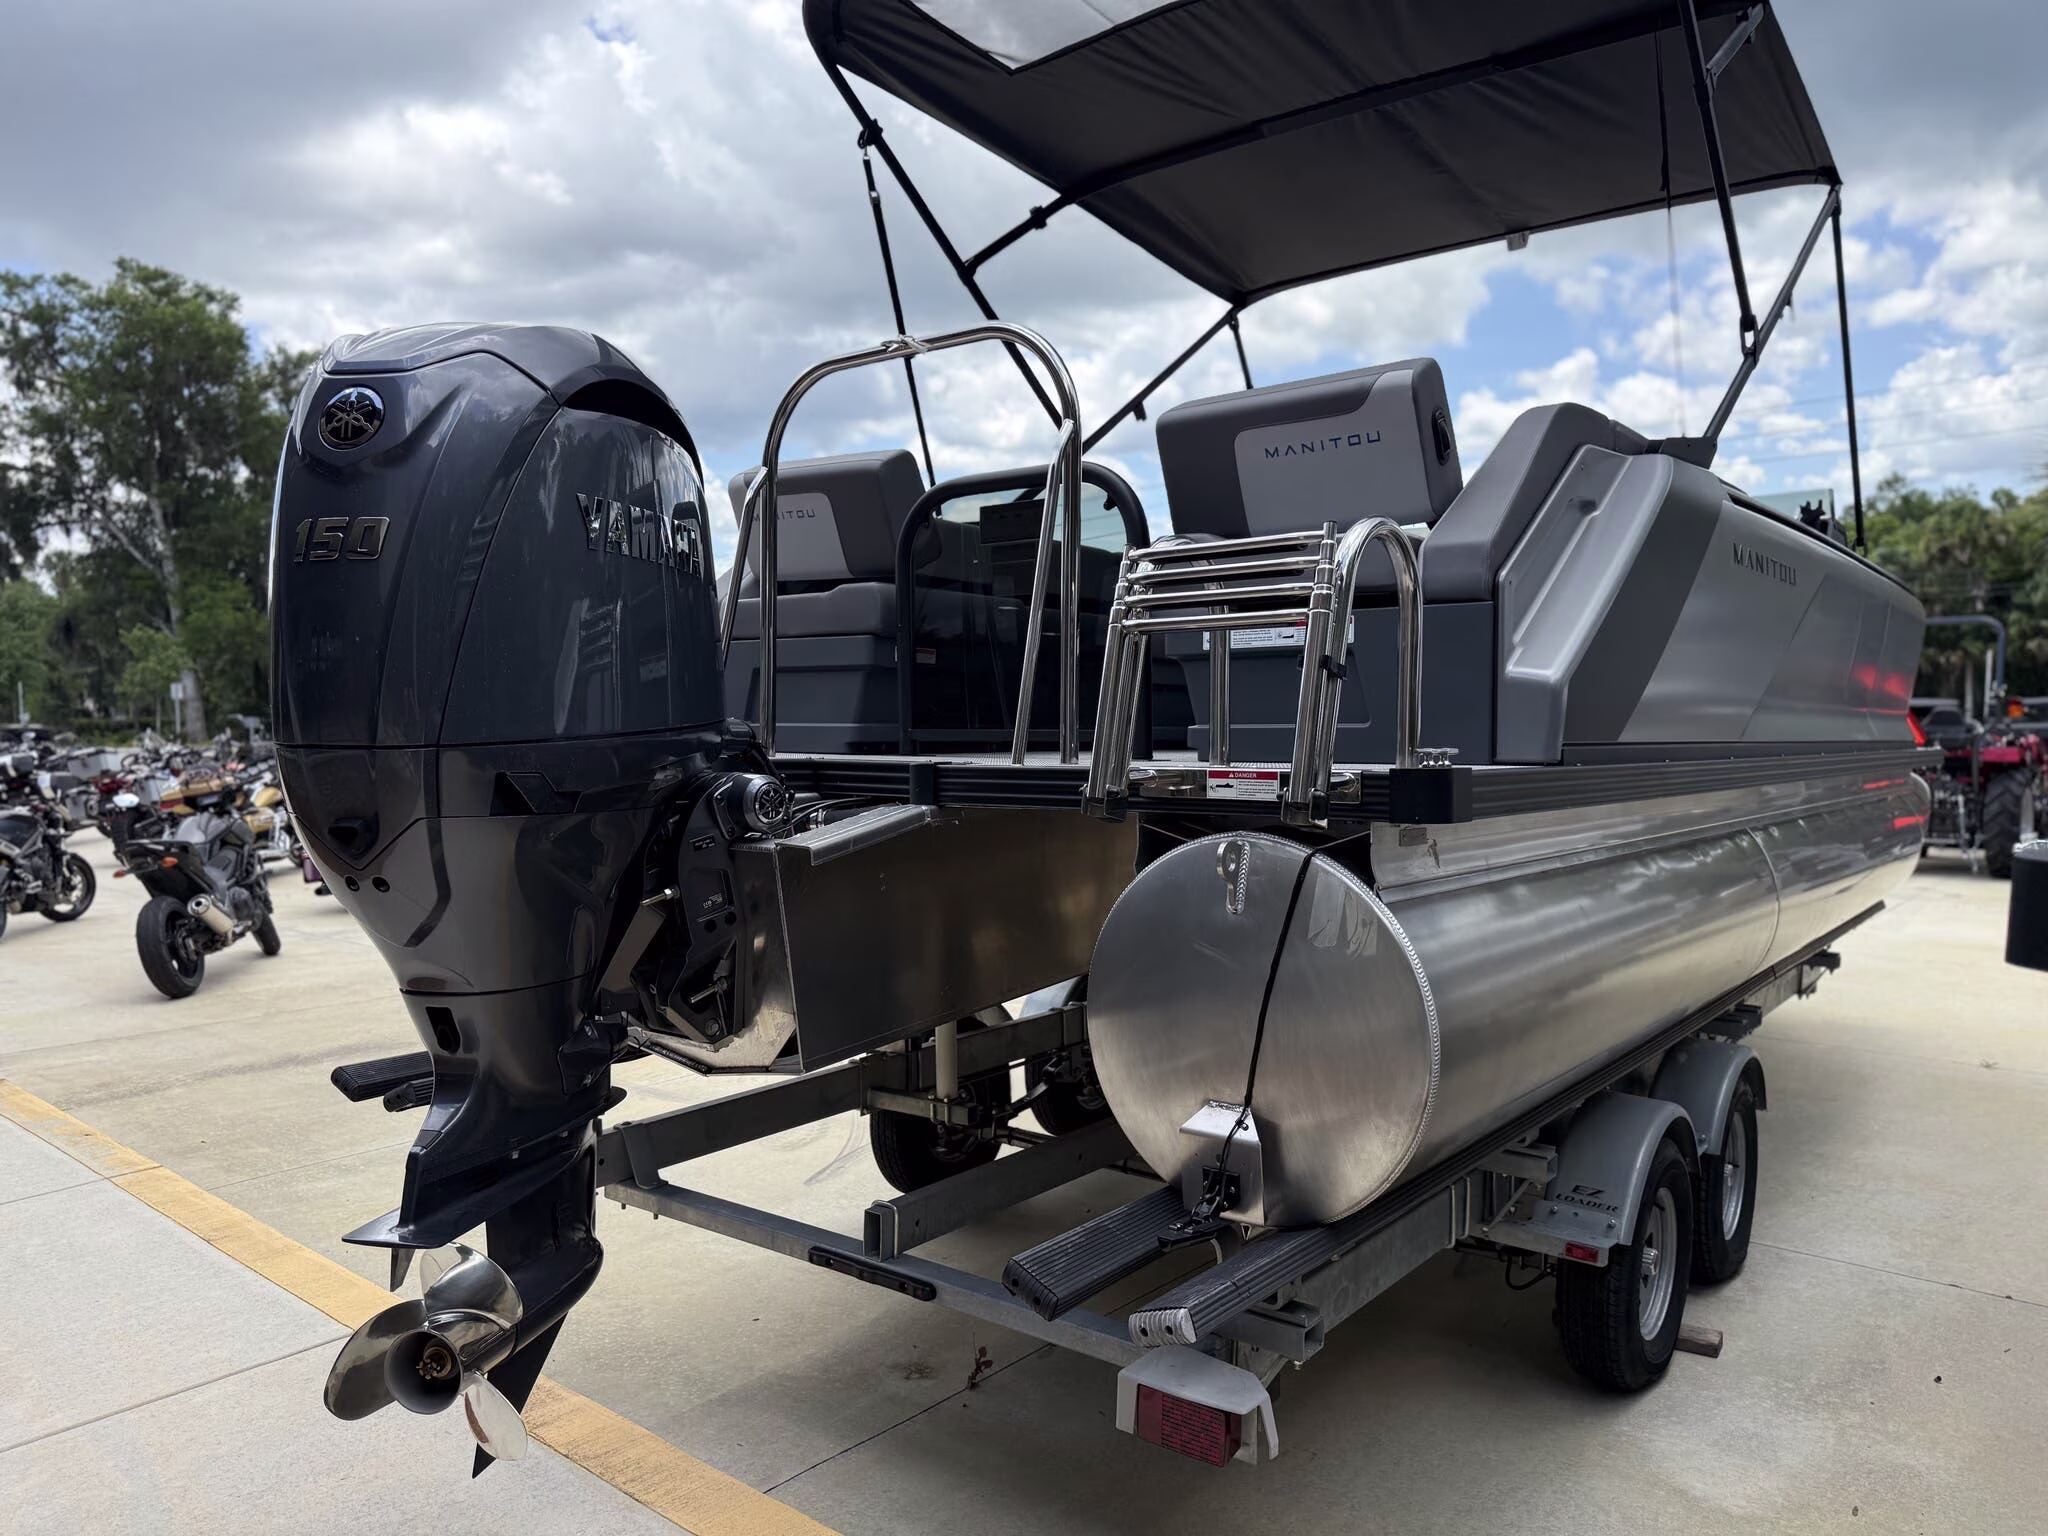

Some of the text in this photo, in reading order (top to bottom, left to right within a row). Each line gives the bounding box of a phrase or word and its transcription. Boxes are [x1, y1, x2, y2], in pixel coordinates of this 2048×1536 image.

[1264, 430, 1381, 459] MANITOU
[293, 516, 390, 562] 150
[576, 492, 704, 578] YAMAHA
[1732, 542, 1797, 586] MANITOU
[1556, 1193, 1619, 1213] LOADER
[1571, 1184, 1605, 1199] EZ
